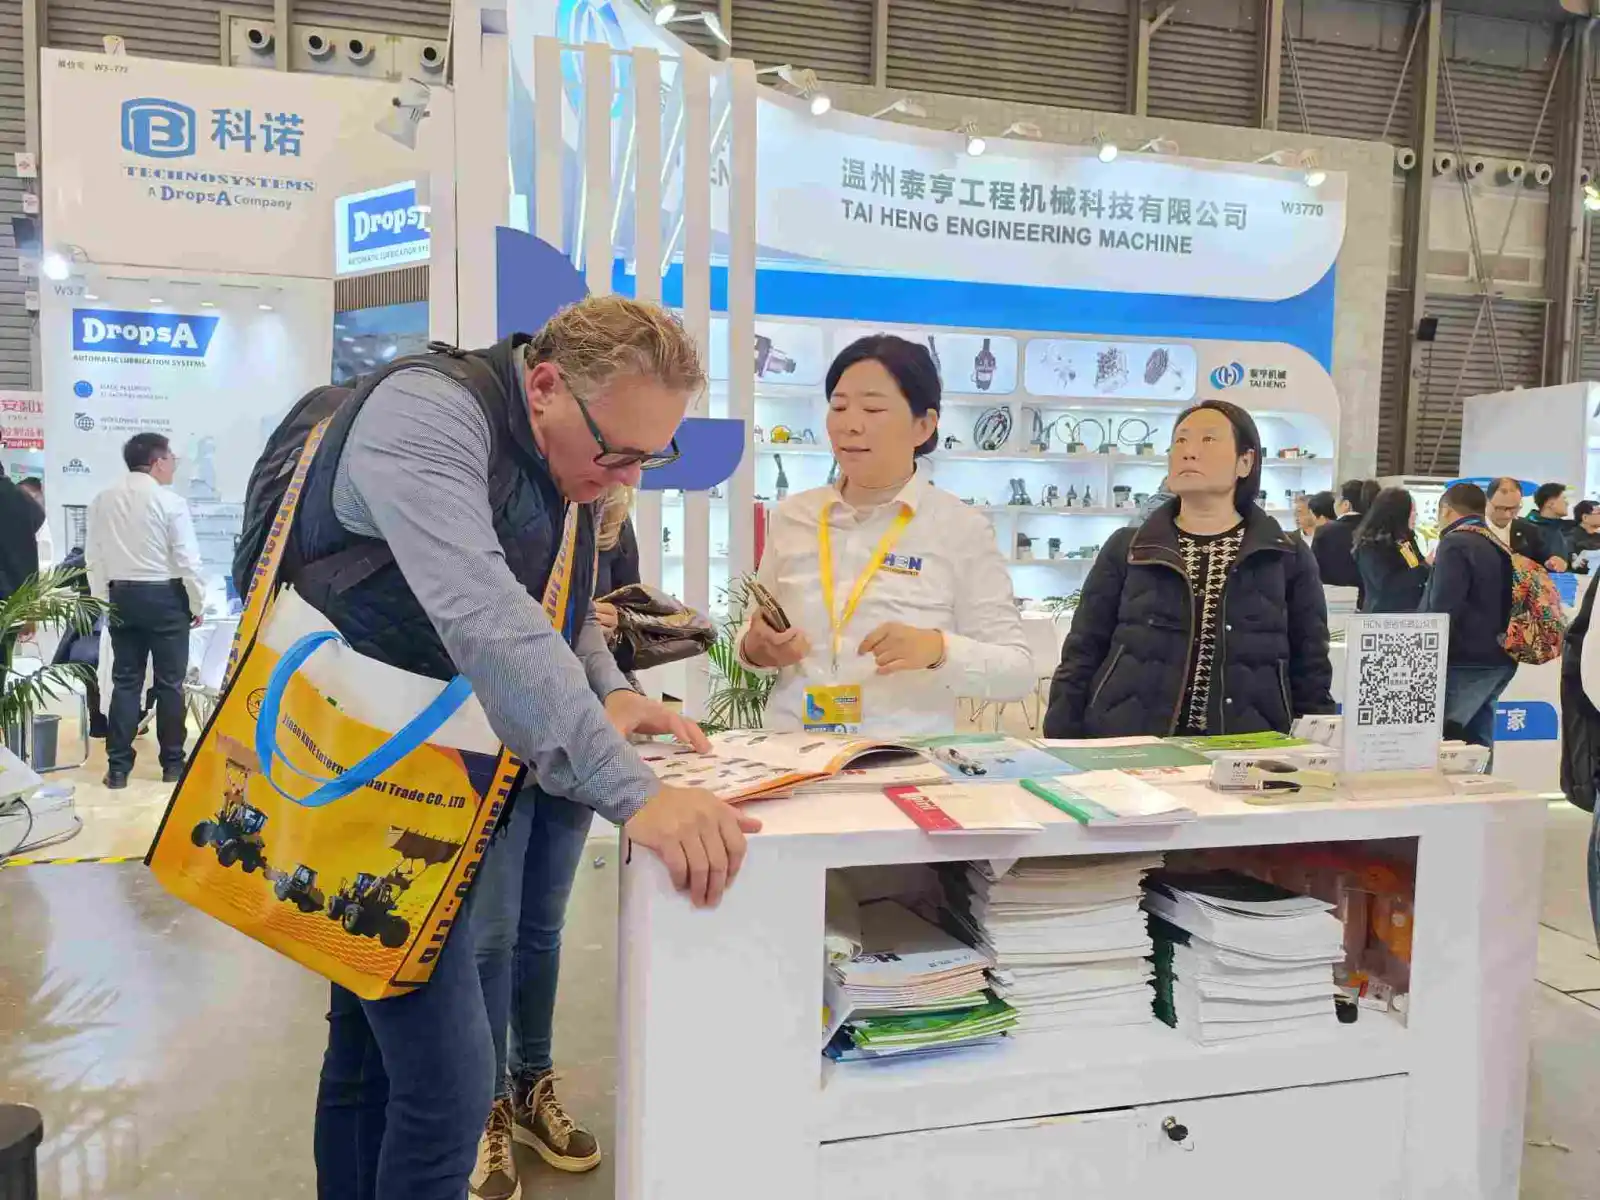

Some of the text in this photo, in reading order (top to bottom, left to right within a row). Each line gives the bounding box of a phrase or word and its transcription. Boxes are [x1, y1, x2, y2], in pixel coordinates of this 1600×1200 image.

[209, 108, 304, 157] 科诺
[124, 165, 315, 192] TECHNOSYSTEMS
[161, 185, 232, 206] DropsA
[234, 194, 292, 210] Company
[842, 157, 1248, 231] 温州泰亨工程机械科技有限公司
[1281, 201, 1324, 216] W3770
[842, 199, 1192, 254] TAI HENG ENGINEERING MACHINE
[82, 317, 199, 349] DropsA
[73, 354, 206, 368] AUTOMATIC LUBRICATION SYSTEMS
[1263, 380, 1286, 388] HENG
[1496, 708, 1527, 732] 家
[388, 782, 424, 804] Trade
[448, 795, 466, 809] LTD
